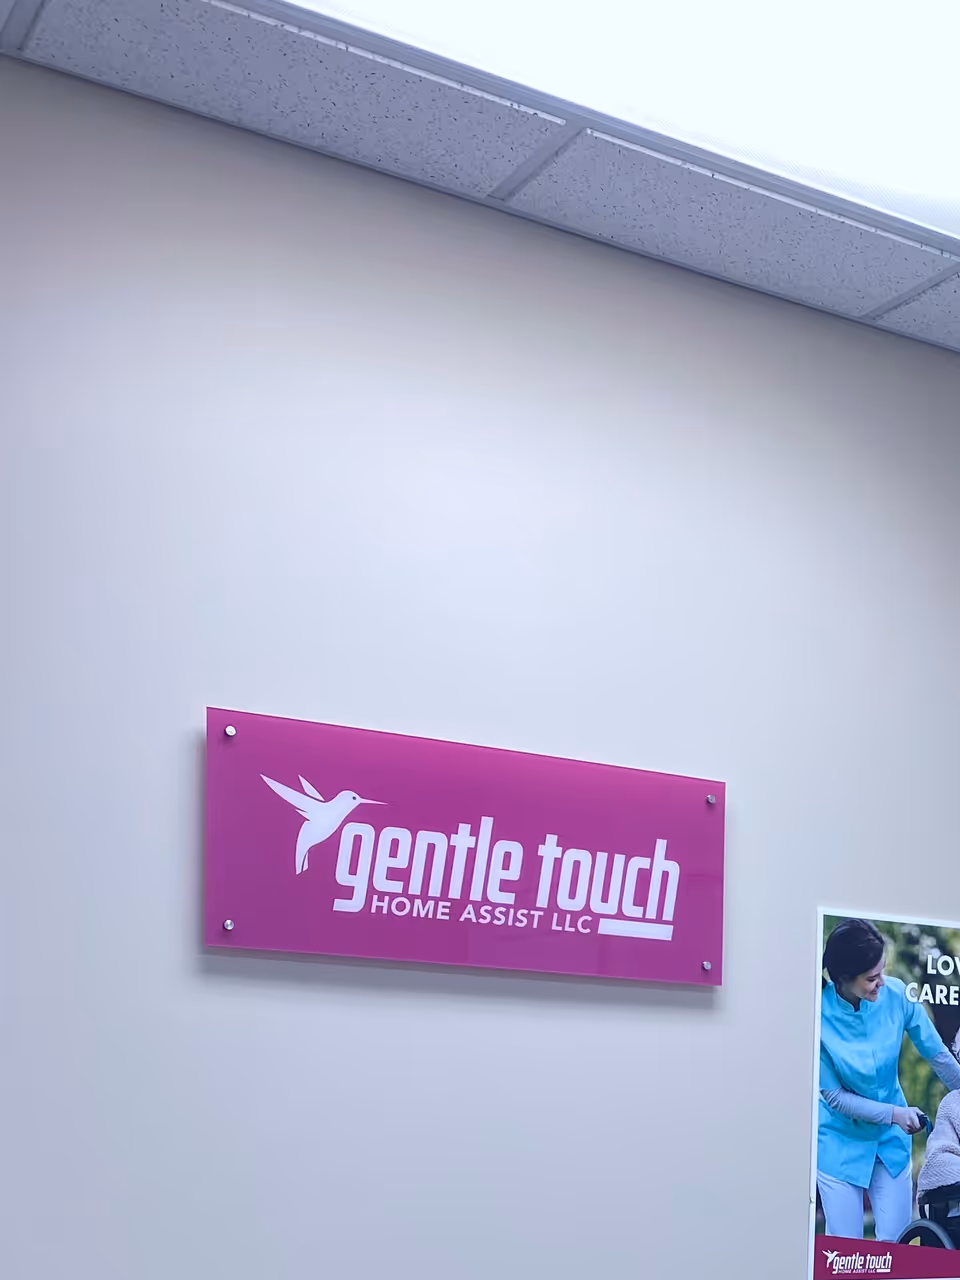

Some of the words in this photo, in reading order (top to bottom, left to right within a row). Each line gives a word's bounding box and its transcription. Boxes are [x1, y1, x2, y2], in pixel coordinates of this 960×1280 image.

[333, 816, 524, 913] gentle
[536, 834, 680, 921] touch
[370, 895, 451, 920] HOME
[459, 904, 544, 929] ASSIST
[552, 913, 592, 934] LLC
[832, 1252, 864, 1274] gentle
[866, 1252, 892, 1269] touch
